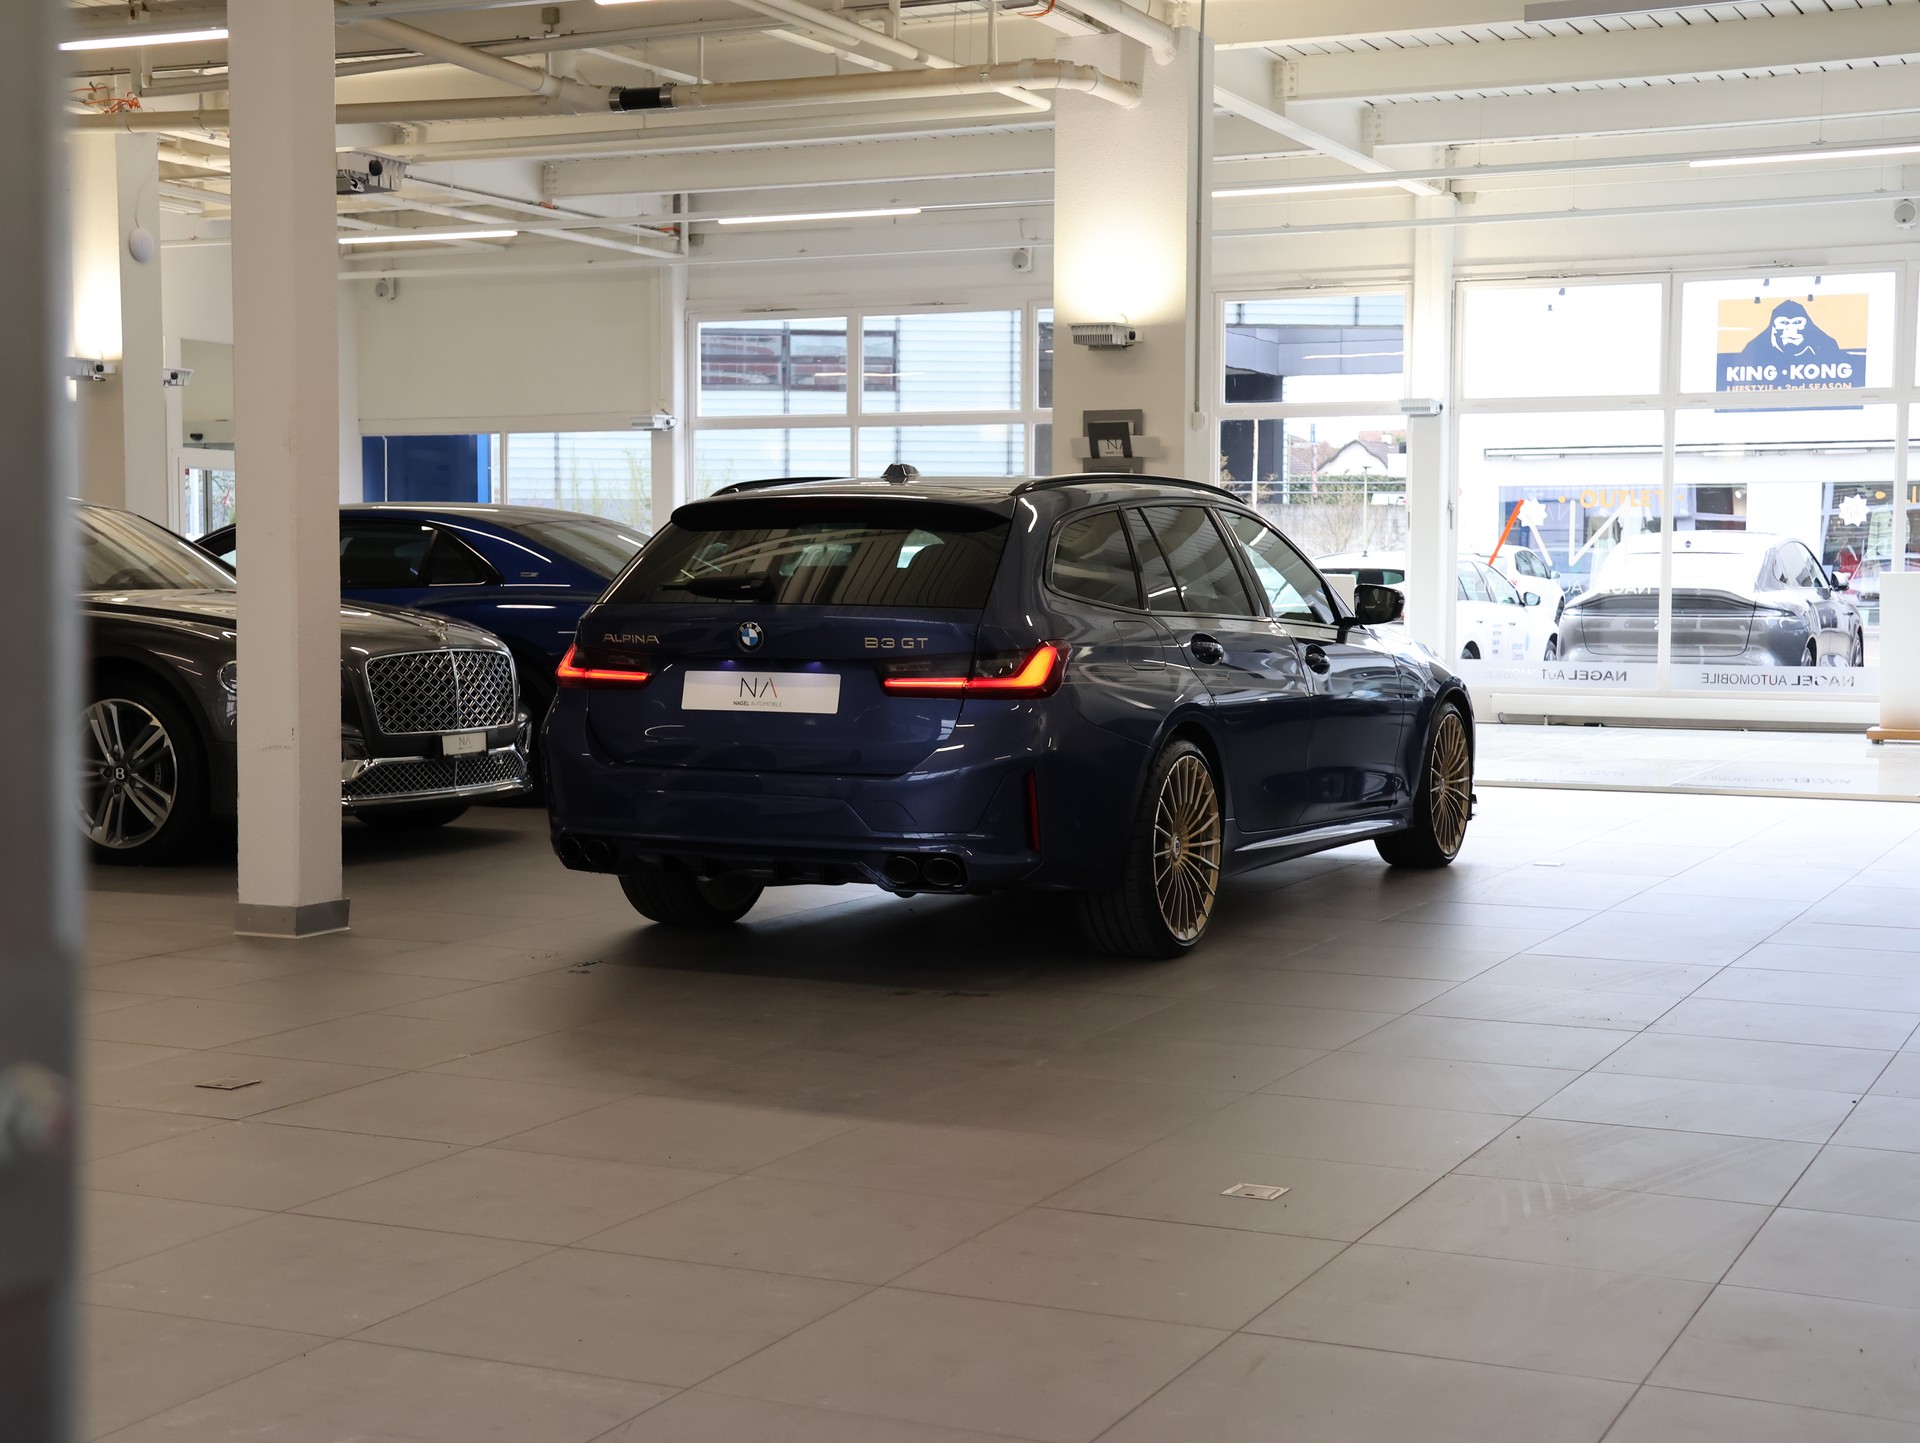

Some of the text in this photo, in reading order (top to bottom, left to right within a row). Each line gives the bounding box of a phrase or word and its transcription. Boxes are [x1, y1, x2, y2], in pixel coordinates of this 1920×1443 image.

[1726, 363, 1853, 381] KING KONG
[603, 633, 660, 645] ALPINA
[864, 637, 929, 649] B3 GT
